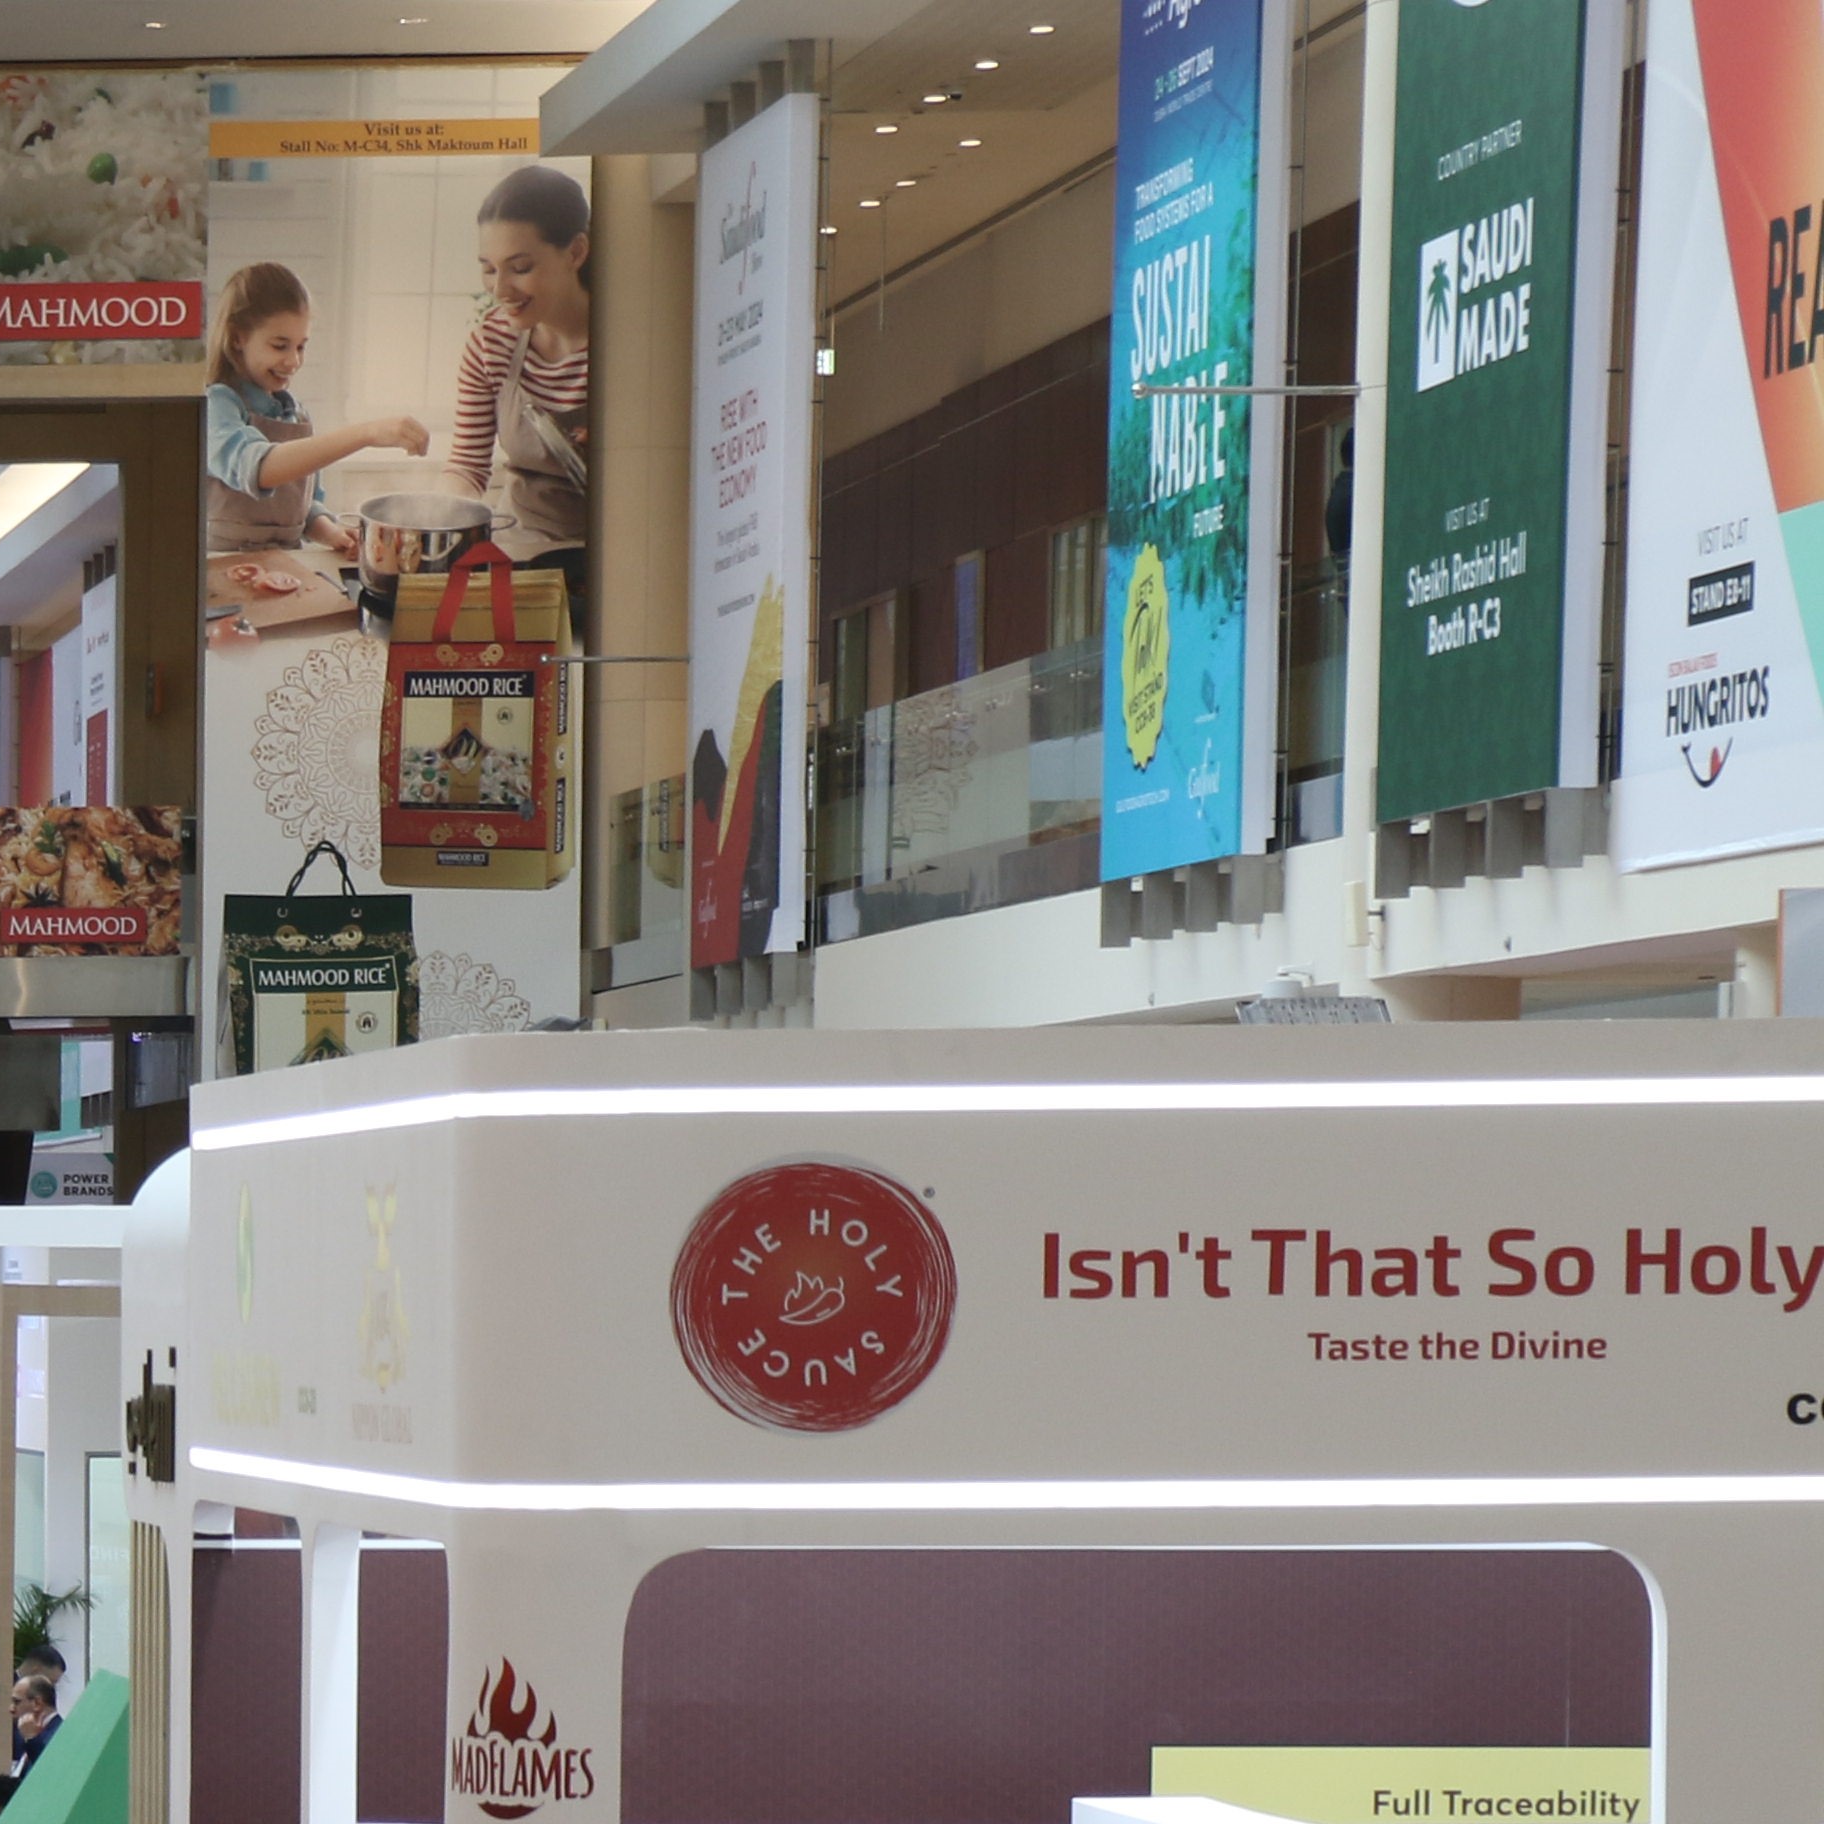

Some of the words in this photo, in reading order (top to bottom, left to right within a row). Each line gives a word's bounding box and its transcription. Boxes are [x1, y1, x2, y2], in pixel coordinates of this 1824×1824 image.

[280, 139, 314, 152] Stall
[318, 138, 341, 152] No:
[343, 138, 394, 154] M-C34,
[397, 137, 424, 151] Shk
[427, 137, 494, 151] Maktoum
[498, 135, 528, 150] Hall
[364, 122, 400, 137] Visit
[404, 125, 419, 137] us
[423, 123, 445, 137] at:
[1437, 143, 1480, 182] COUNTRY
[1480, 119, 1523, 161] PARTNER
[1134, 211, 1155, 245] FOOD
[1156, 193, 1190, 233] SYSTEMS
[1459, 197, 1534, 295] SAUDI
[1131, 234, 1211, 381] SUSTAI
[1456, 283, 1531, 375] MADE
[1193, 503, 1225, 540] FUTURE
[1407, 560, 1450, 608] Sheikh
[1450, 540, 1496, 595] Rashid
[1497, 529, 1527, 581] Hall
[1689, 582, 1724, 616] STAND
[1426, 606, 1466, 657] Booth
[1467, 597, 1502, 644] R-C3
[409, 676, 490, 697] MAHMOOD
[492, 677, 524, 696] RICE
[1666, 666, 1770, 738] HUNGRITOS
[8, 914, 139, 938] MAHMOOD
[258, 968, 350, 988] MAHMOOD
[353, 967, 387, 985] RICE
[63, 1174, 109, 1184] POWER
[63, 1186, 114, 1197] BRANDS
[721, 1223, 782, 1306] THE
[808, 1208, 904, 1299] HOLY
[1042, 1231, 1232, 1300] Isn't
[1251, 1229, 1461, 1299] That
[1485, 1229, 1596, 1298] So
[1625, 1227, 1824, 1310] Holy
[737, 1326, 885, 1387] SAUCE
[1307, 1332, 1409, 1361] Taste
[1418, 1334, 1480, 1361] the
[1491, 1331, 1608, 1360] Divine
[1372, 1790, 1431, 1816] Full
[1442, 1790, 1641, 1822] Traceability
